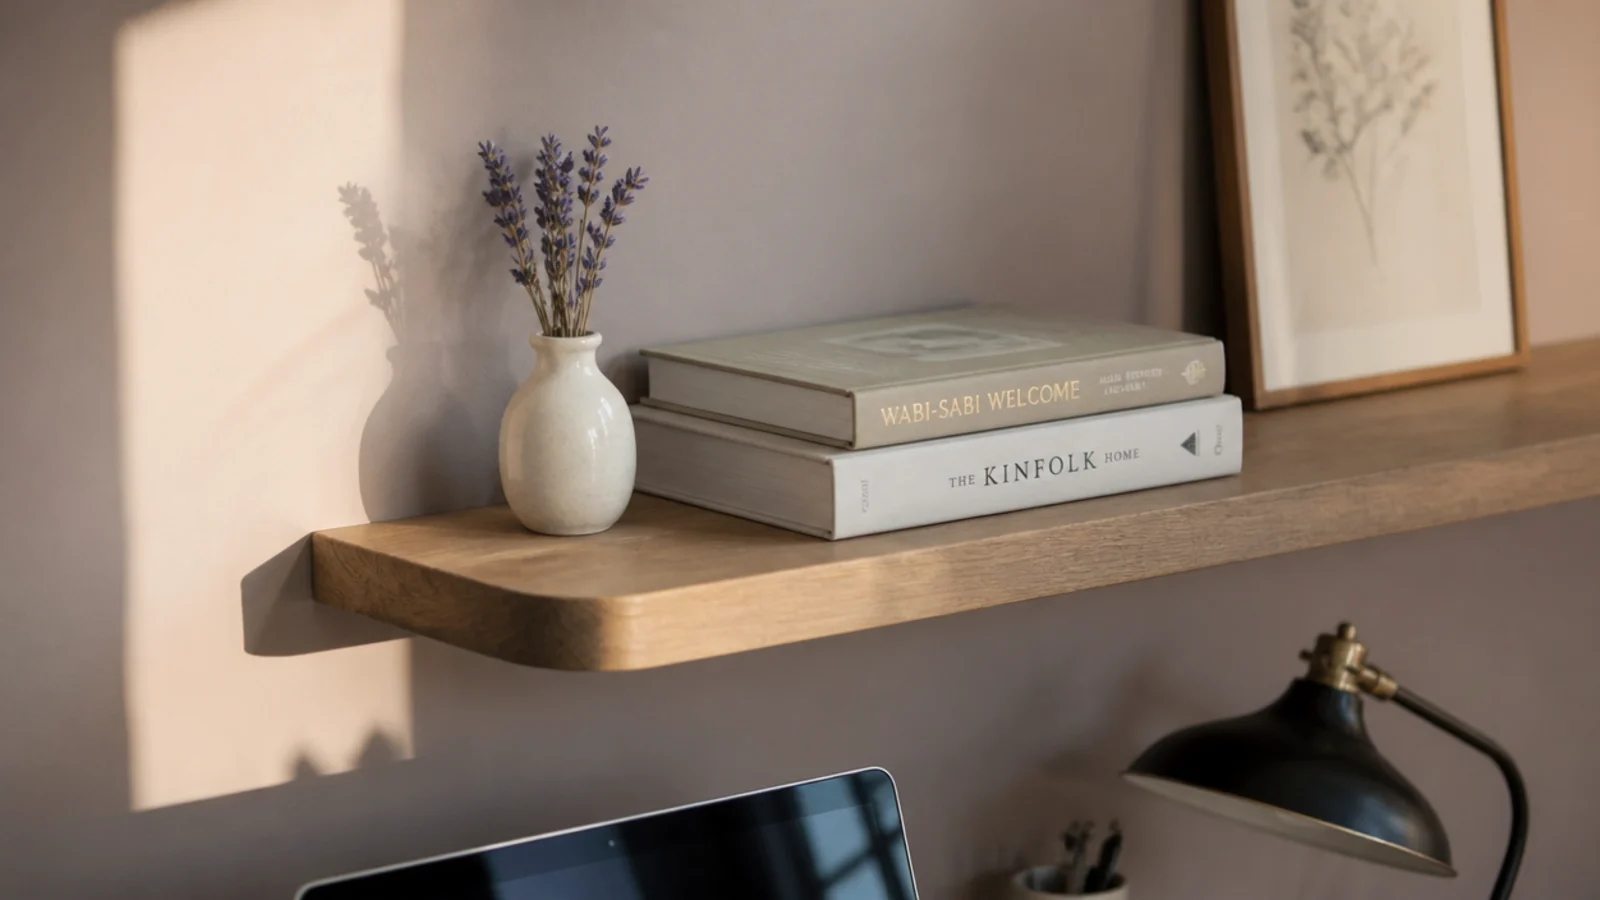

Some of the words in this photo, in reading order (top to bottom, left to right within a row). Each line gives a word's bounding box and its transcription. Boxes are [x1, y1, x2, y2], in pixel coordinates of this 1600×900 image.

[880, 395, 980, 426] WABI-SABI
[987, 380, 1080, 411] WELCOME
[948, 474, 976, 488] THE
[984, 451, 1097, 487] KINFOLK
[1104, 448, 1140, 464] HOME
